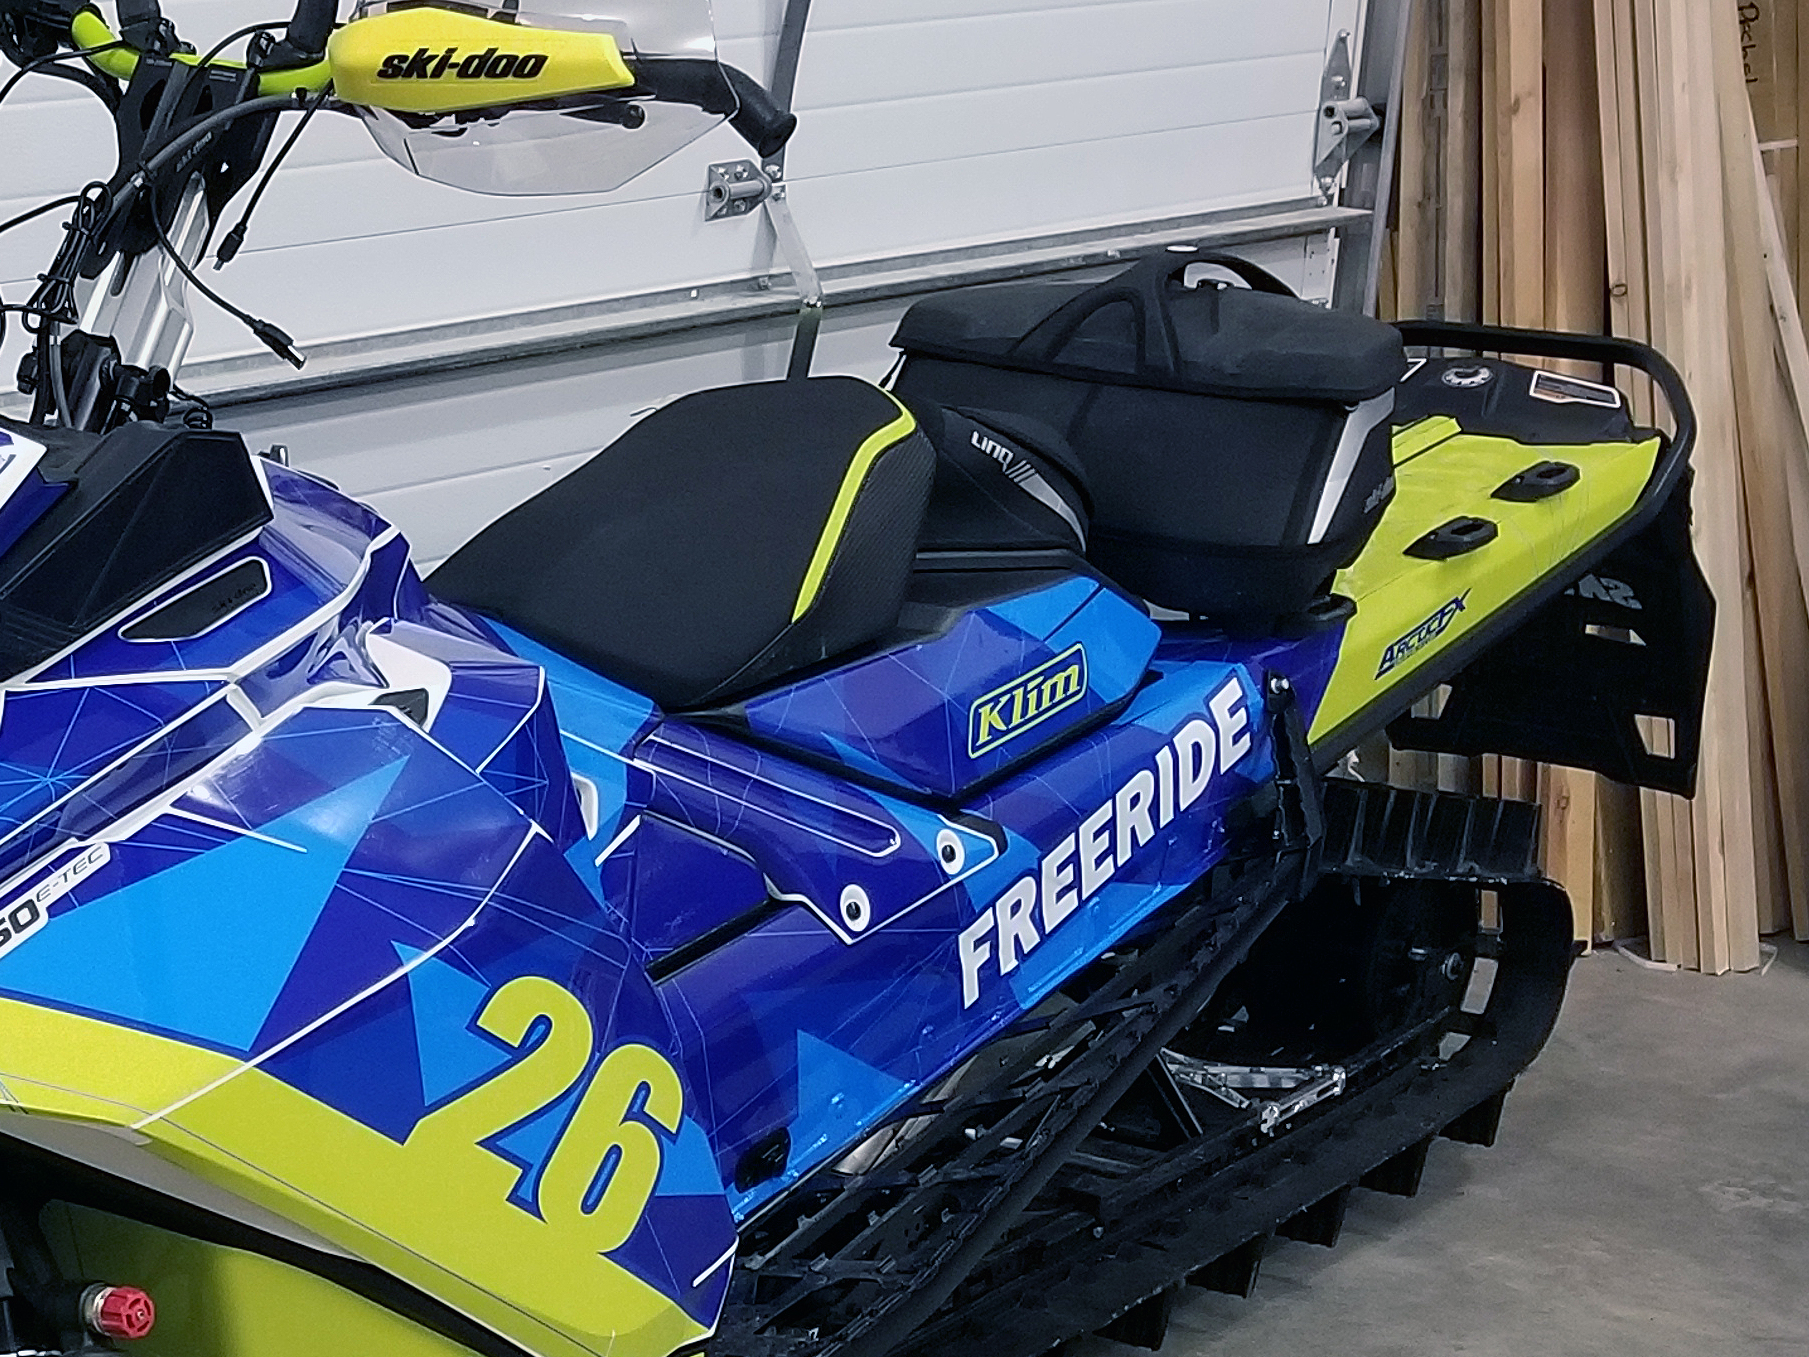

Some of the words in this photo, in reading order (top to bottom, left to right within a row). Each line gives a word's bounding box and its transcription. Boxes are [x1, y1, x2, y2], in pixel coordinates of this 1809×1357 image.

[377, 47, 549, 79] ski-doo
[36, 846, 104, 902] E-TEC
[957, 676, 1253, 1010] FREERIDE
[401, 975, 684, 1254] 26
